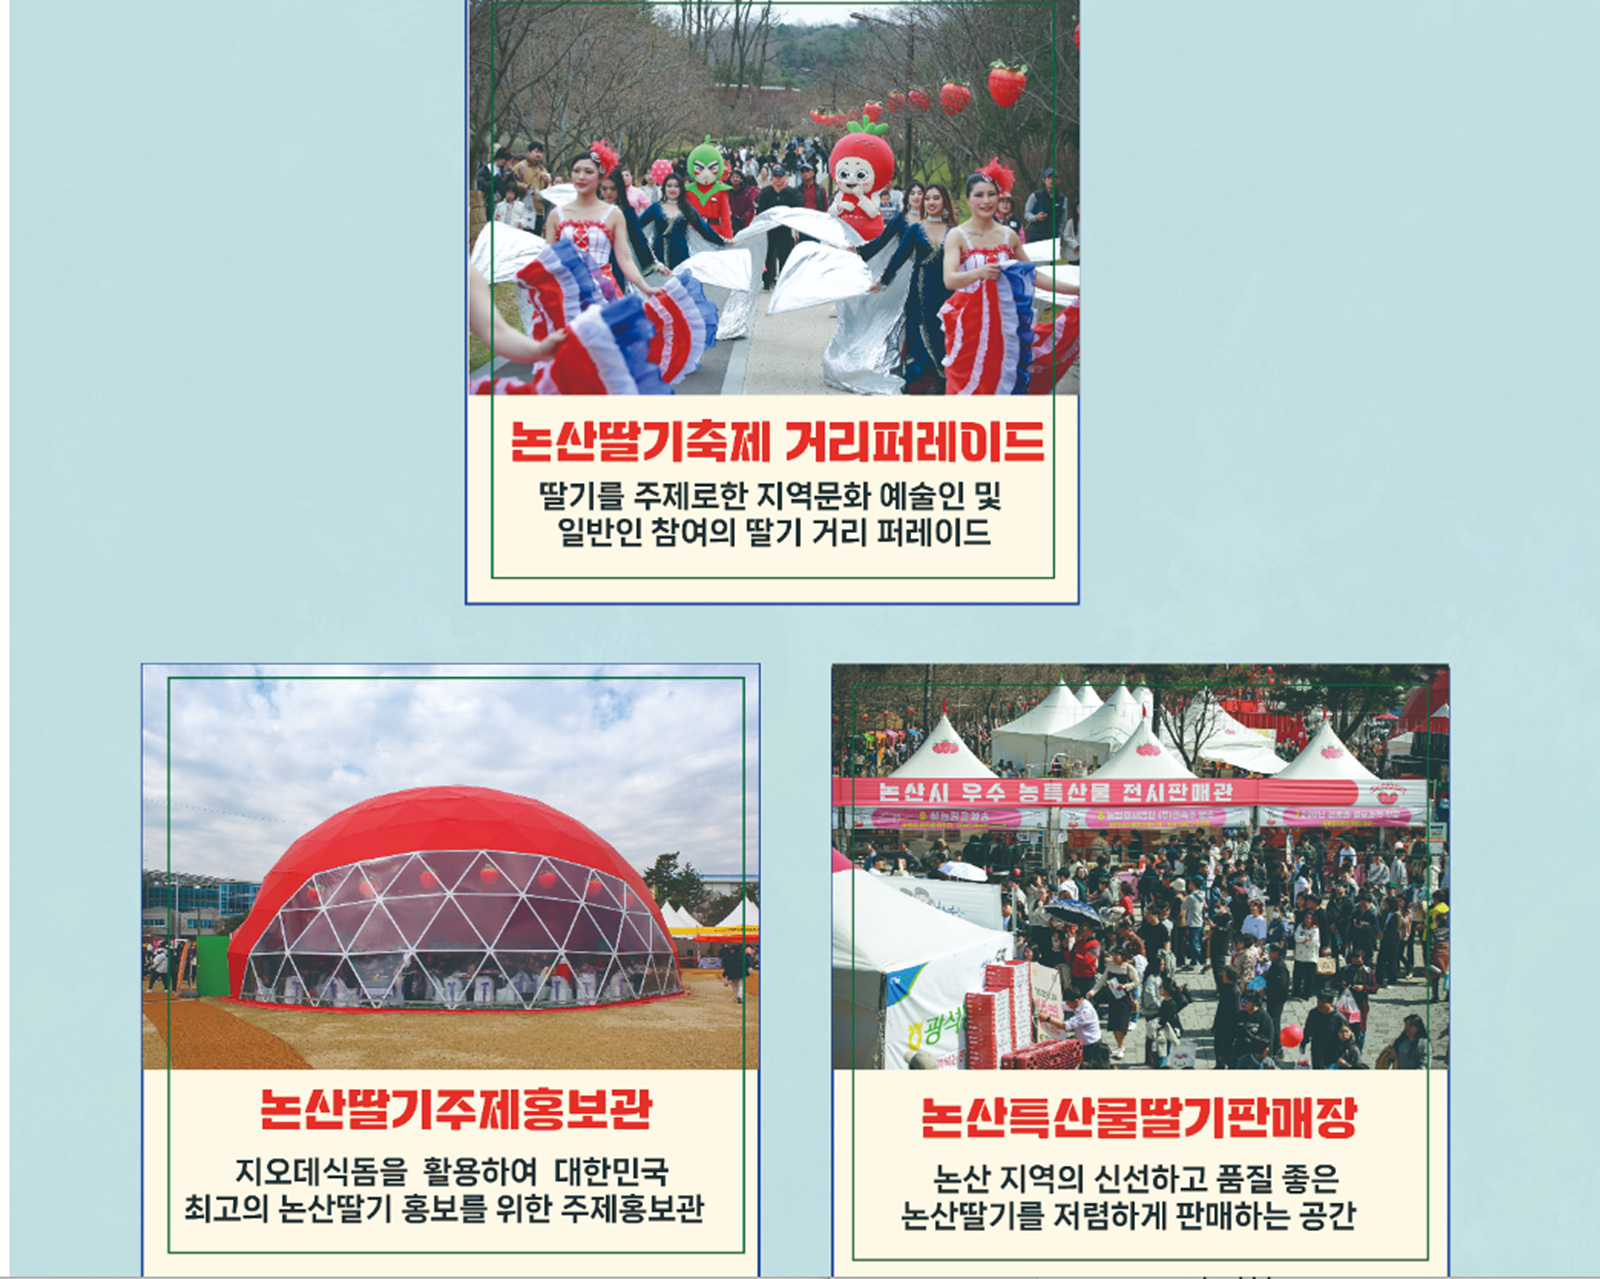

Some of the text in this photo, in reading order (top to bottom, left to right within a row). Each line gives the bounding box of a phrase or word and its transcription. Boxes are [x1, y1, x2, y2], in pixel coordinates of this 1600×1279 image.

[511, 418, 1045, 463] 논산딸기축제 거리퍼레이드
[540, 482, 1001, 511] 딸기를 주제로한 지역문화 예술인 및
[558, 517, 991, 547] 일반인 참여의 딸기 거리 퍼레이드
[879, 782, 1234, 803] 논산시 우수 농특산물 전시판매관
[924, 1005, 967, 1046] 광석
[260, 1086, 654, 1131] 논산딸기주제홍보관
[922, 1096, 1358, 1140] 논산특산물딸기판매장
[236, 1157, 669, 1187] 지오데식돔을 활용하여 대한민국
[934, 1164, 1339, 1194] 논산 지역의 신선하고 품질 좋은
[185, 1194, 704, 1223] 최고의 논산딸기 홍보를 위한 주제홍보관
[902, 1201, 1356, 1231] 논산딸기를 저렴하게 판매하는 공간
